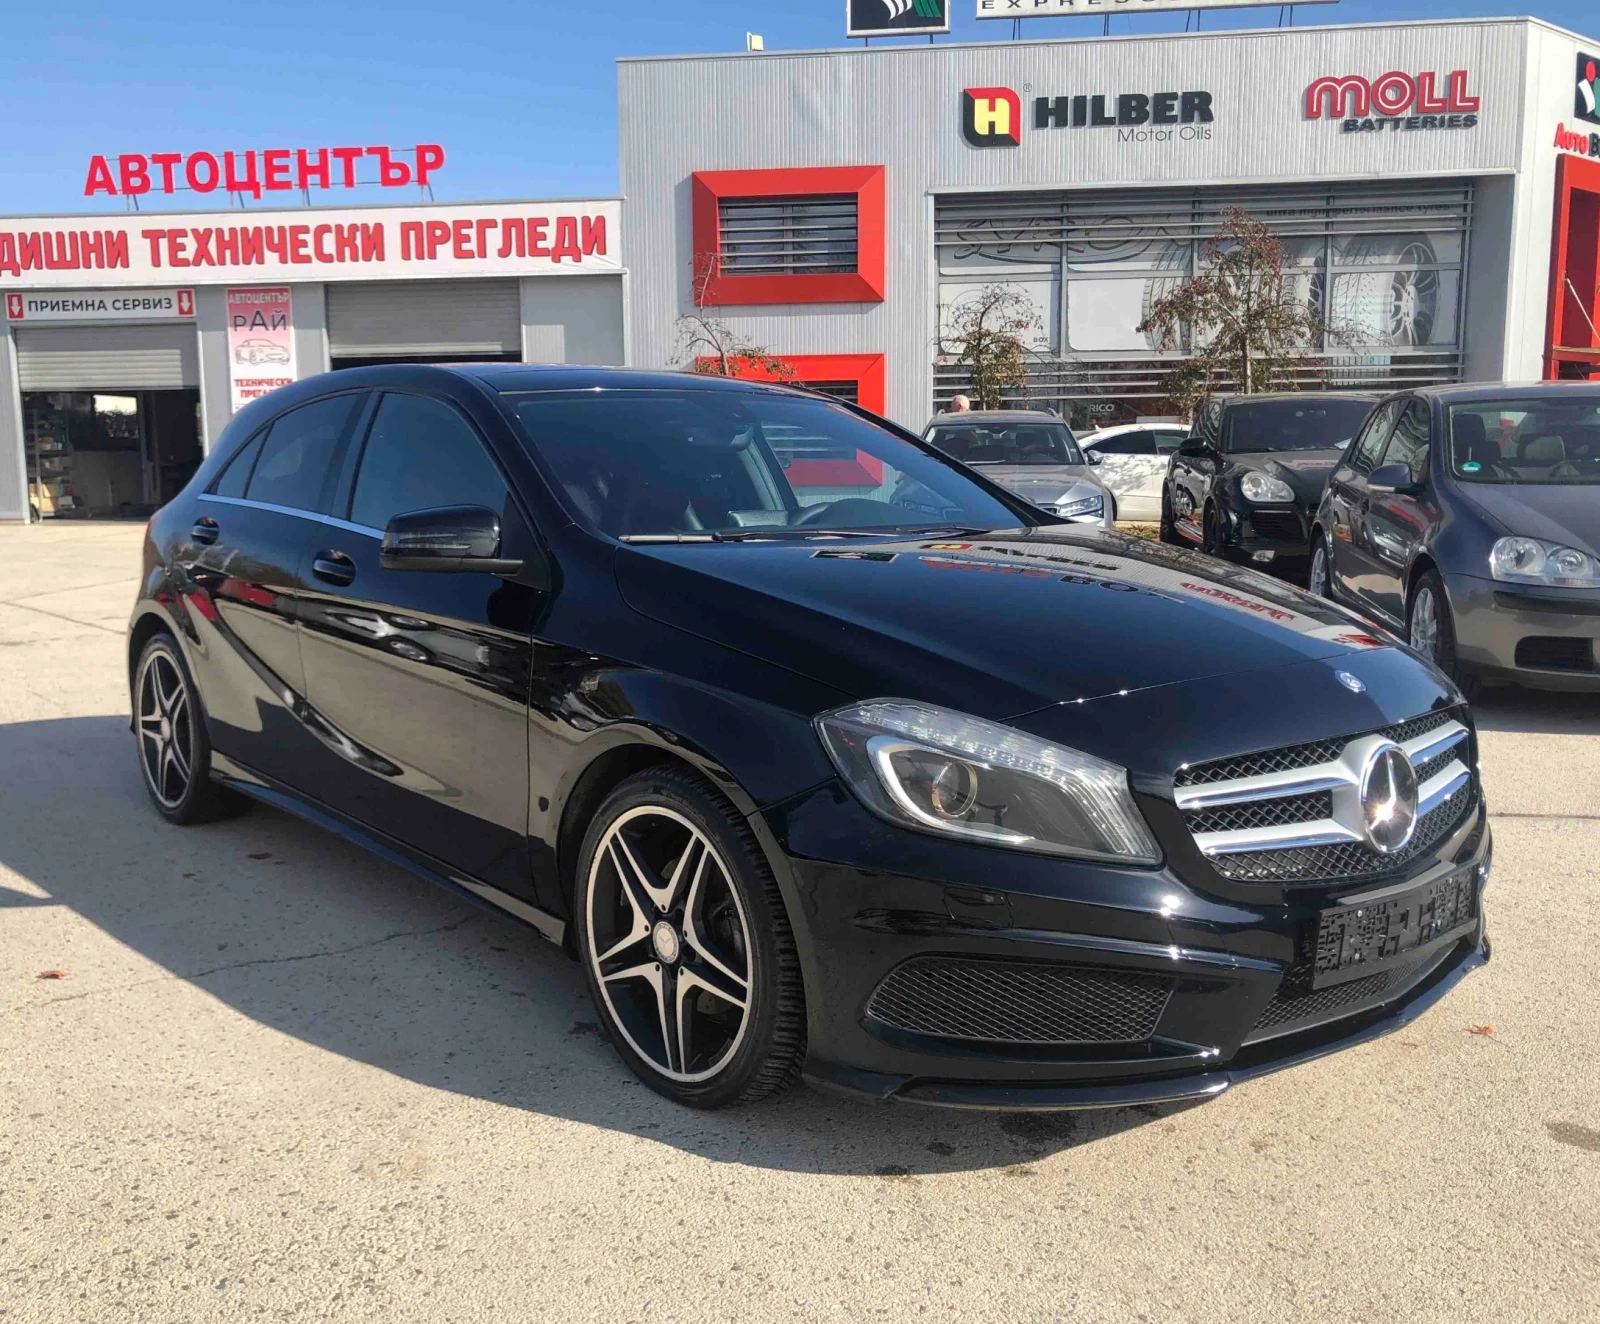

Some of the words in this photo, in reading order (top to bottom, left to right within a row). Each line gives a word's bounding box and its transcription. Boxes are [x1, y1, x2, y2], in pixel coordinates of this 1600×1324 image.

[1035, 91, 1214, 129] HILBER
[1342, 114, 1478, 132] BATTERIES
[1117, 127, 1174, 143] Motor
[1179, 125, 1213, 141] Oils
[83, 144, 446, 200] АВТОЦЕНТЪР
[141, 222, 386, 268] ТЕХНИЧЕСКИ
[400, 215, 607, 264] ПРЕГЛЕДИ
[28, 299, 108, 313] ПРИЕМНА
[112, 297, 173, 311] СЕРВИЗ
[229, 292, 290, 305] АВТОЦЕНТЪР
[233, 309, 288, 332] РАЙ
[1089, 403, 1115, 412] RICO
